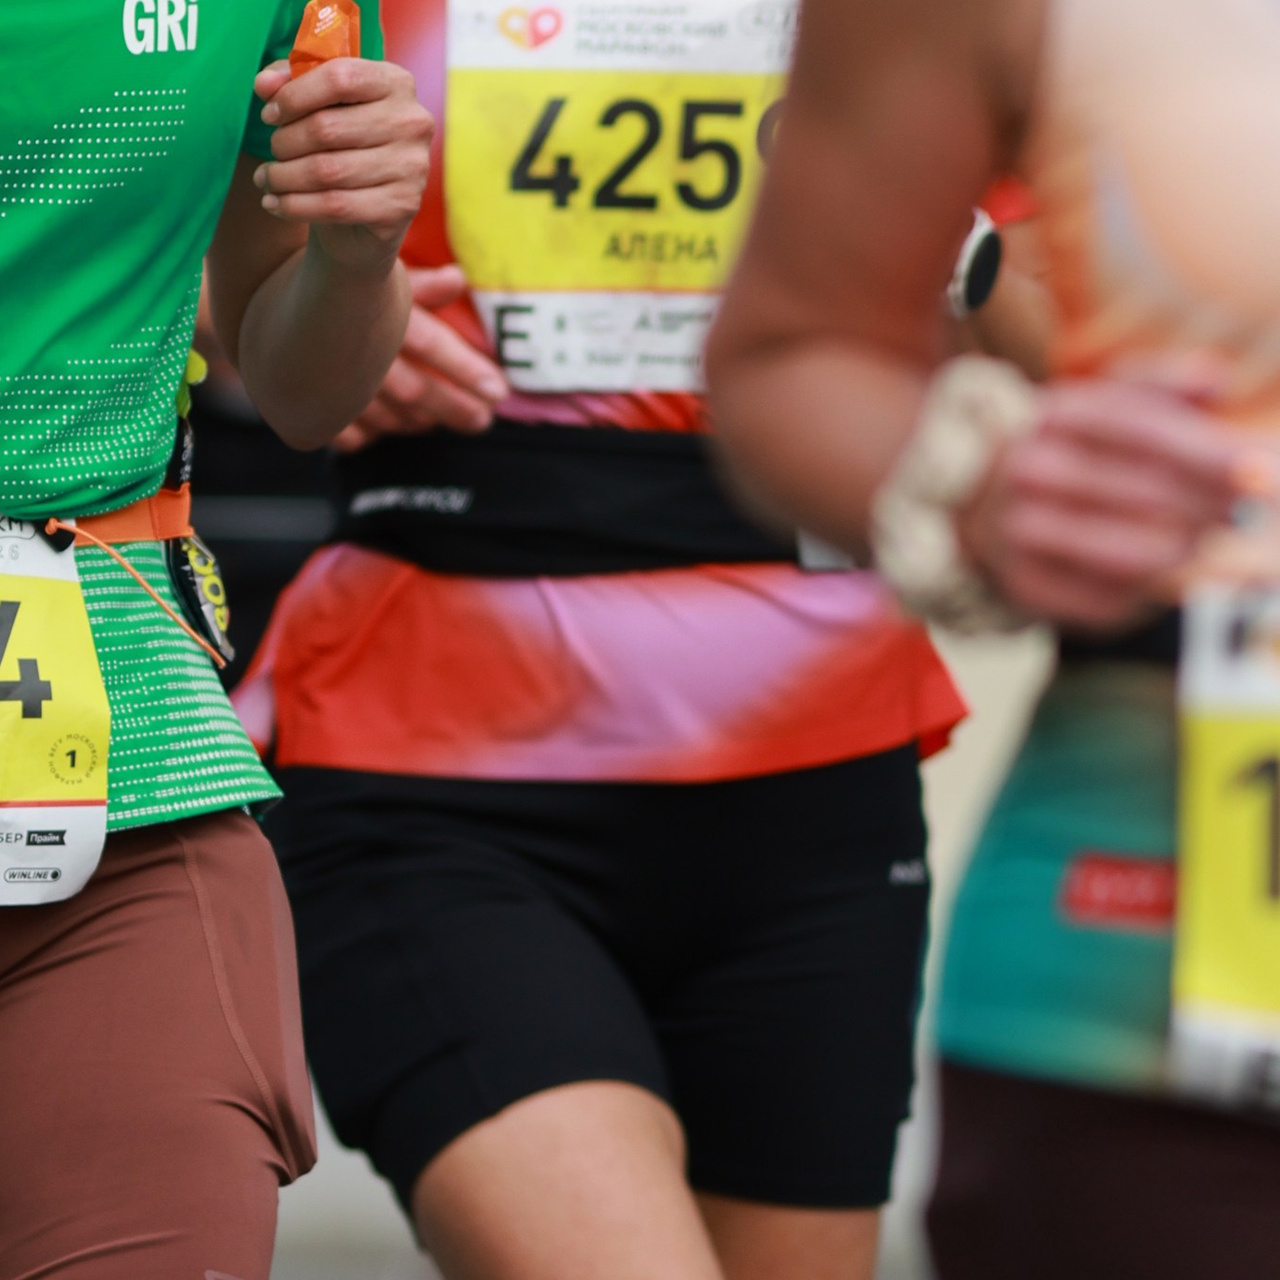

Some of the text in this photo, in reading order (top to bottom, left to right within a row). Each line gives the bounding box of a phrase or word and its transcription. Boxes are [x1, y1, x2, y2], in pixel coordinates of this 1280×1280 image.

[65, 749, 76, 769] 1
[29, 832, 61, 844] Прайм
[8, 871, 50, 881] WINLINE
